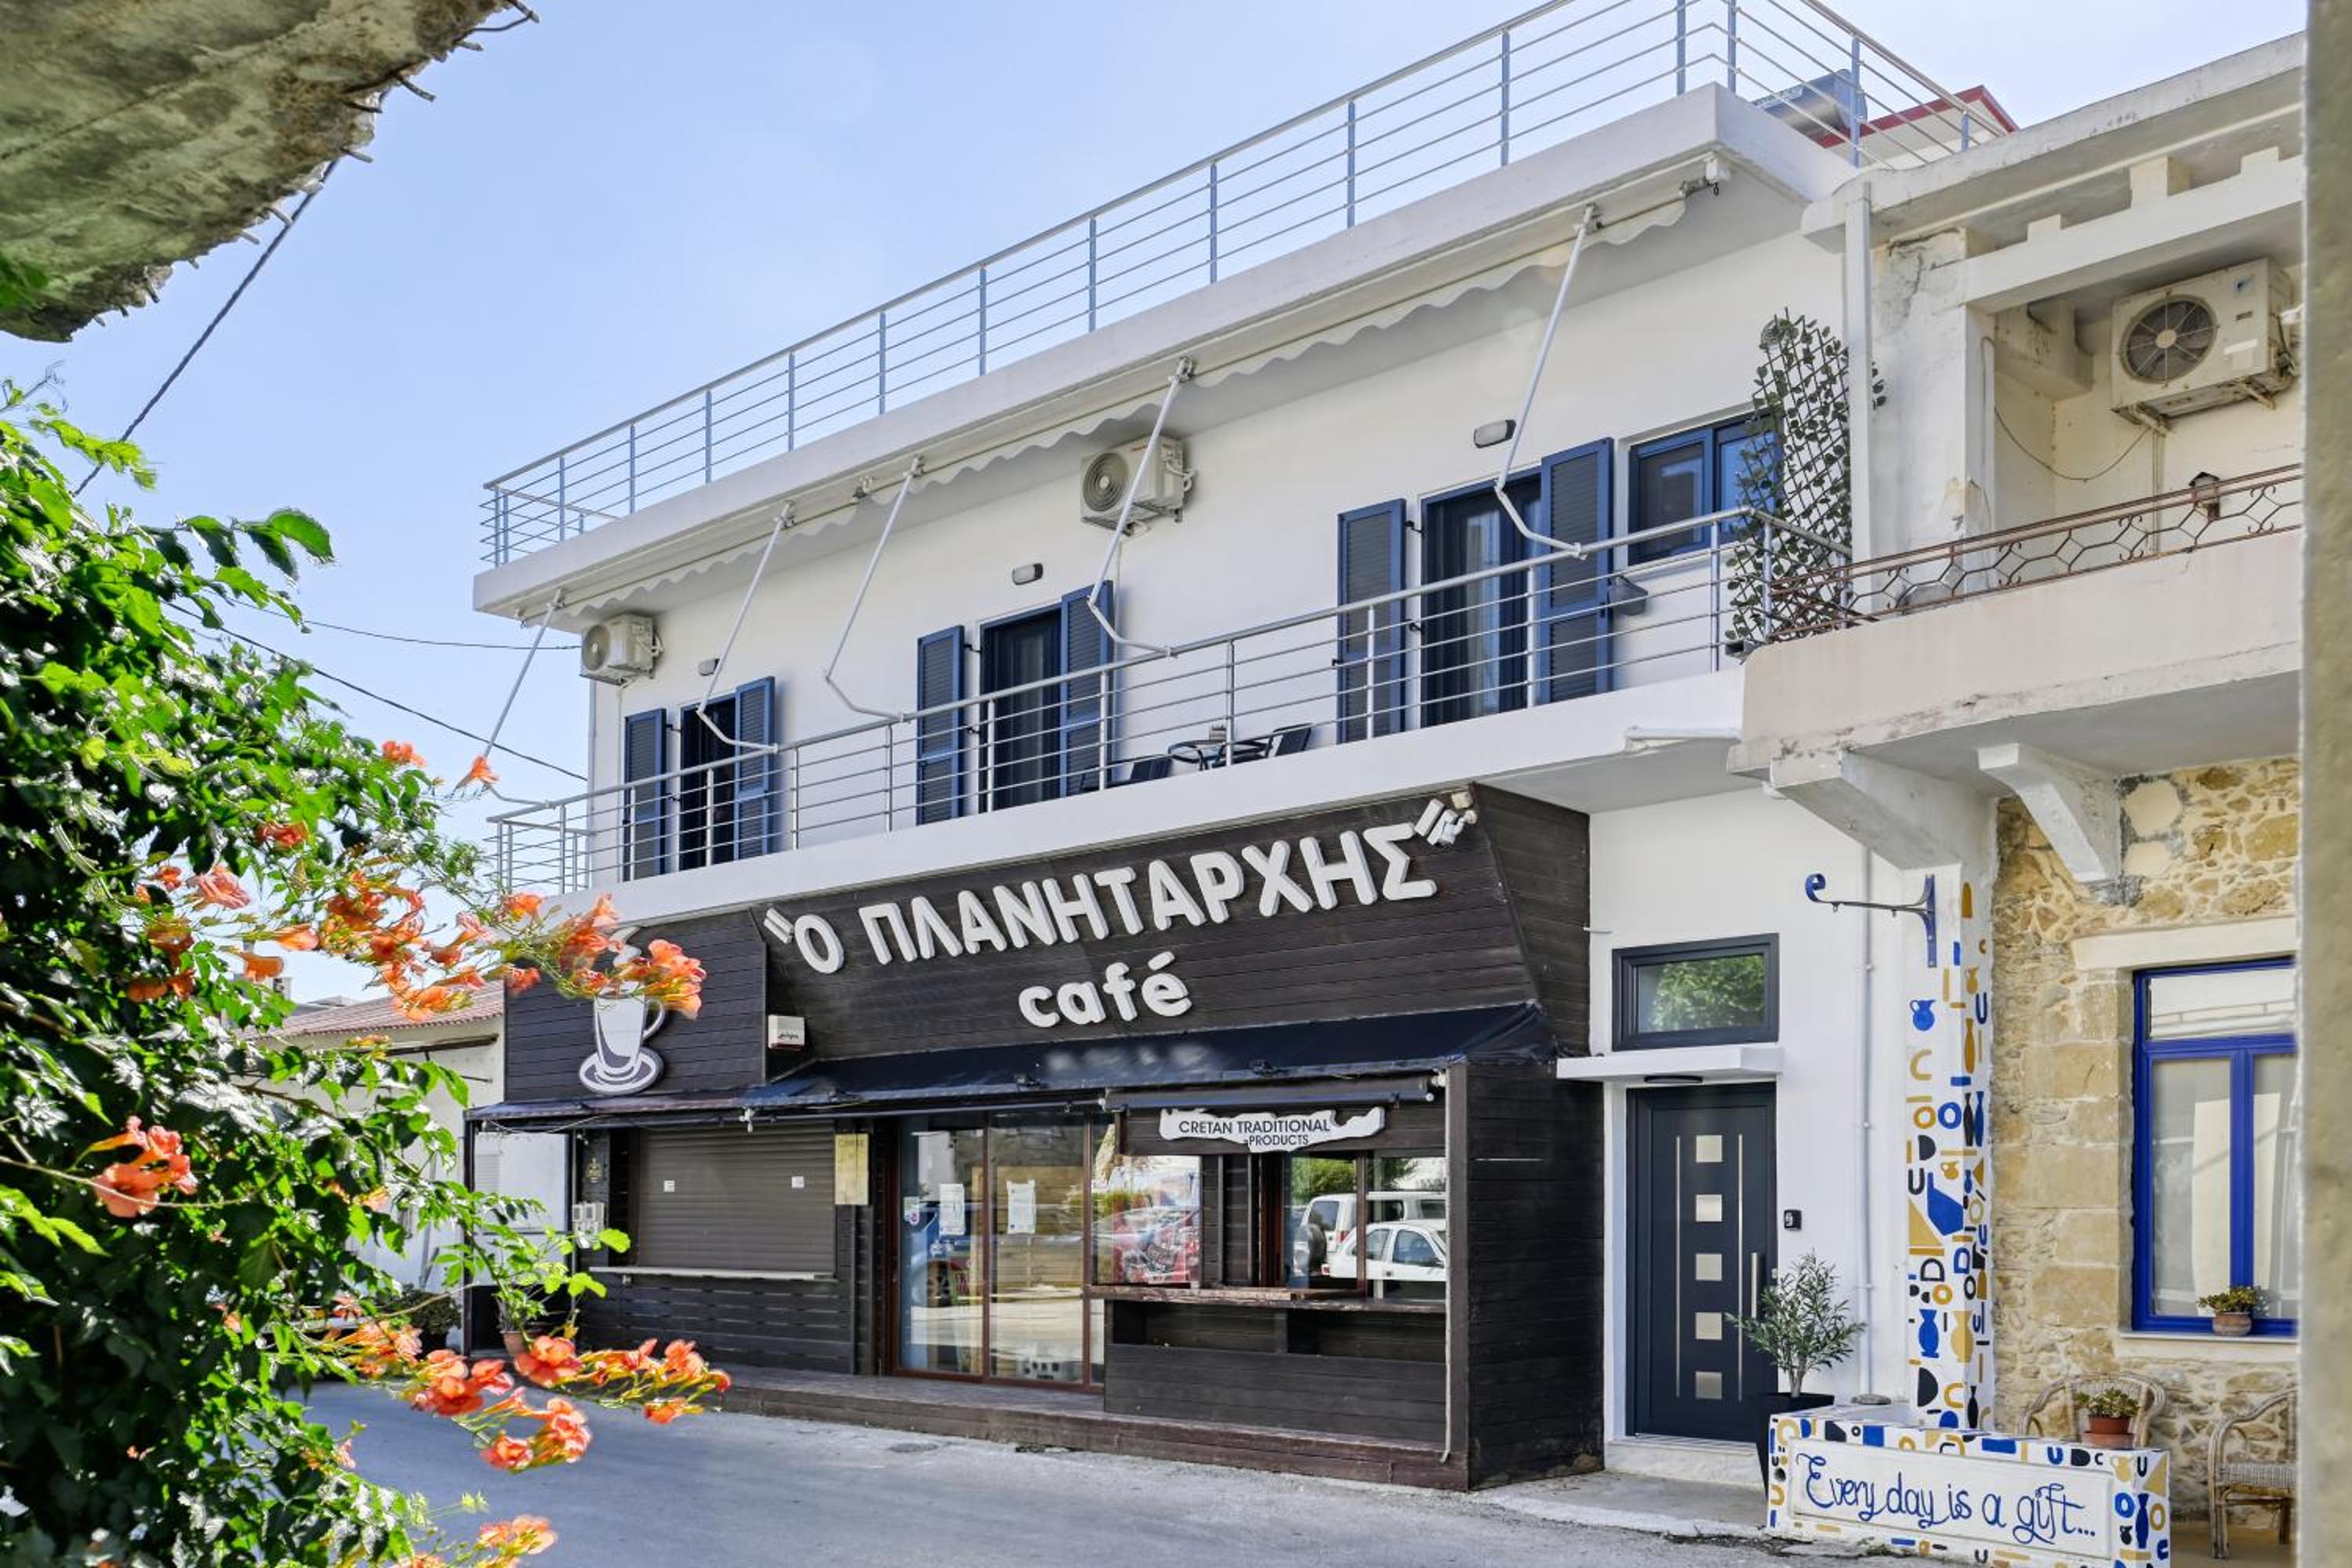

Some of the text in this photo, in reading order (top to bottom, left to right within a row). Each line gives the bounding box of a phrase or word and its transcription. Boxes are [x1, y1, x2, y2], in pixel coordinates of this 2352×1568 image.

[1018, 950, 1192, 1028] café
[1179, 1119, 1330, 1134] CRETAN TRADITIONAL
[1249, 1134, 1308, 1146] PRODUCTS
[1796, 1453, 2096, 1544] Every day is a gift...
